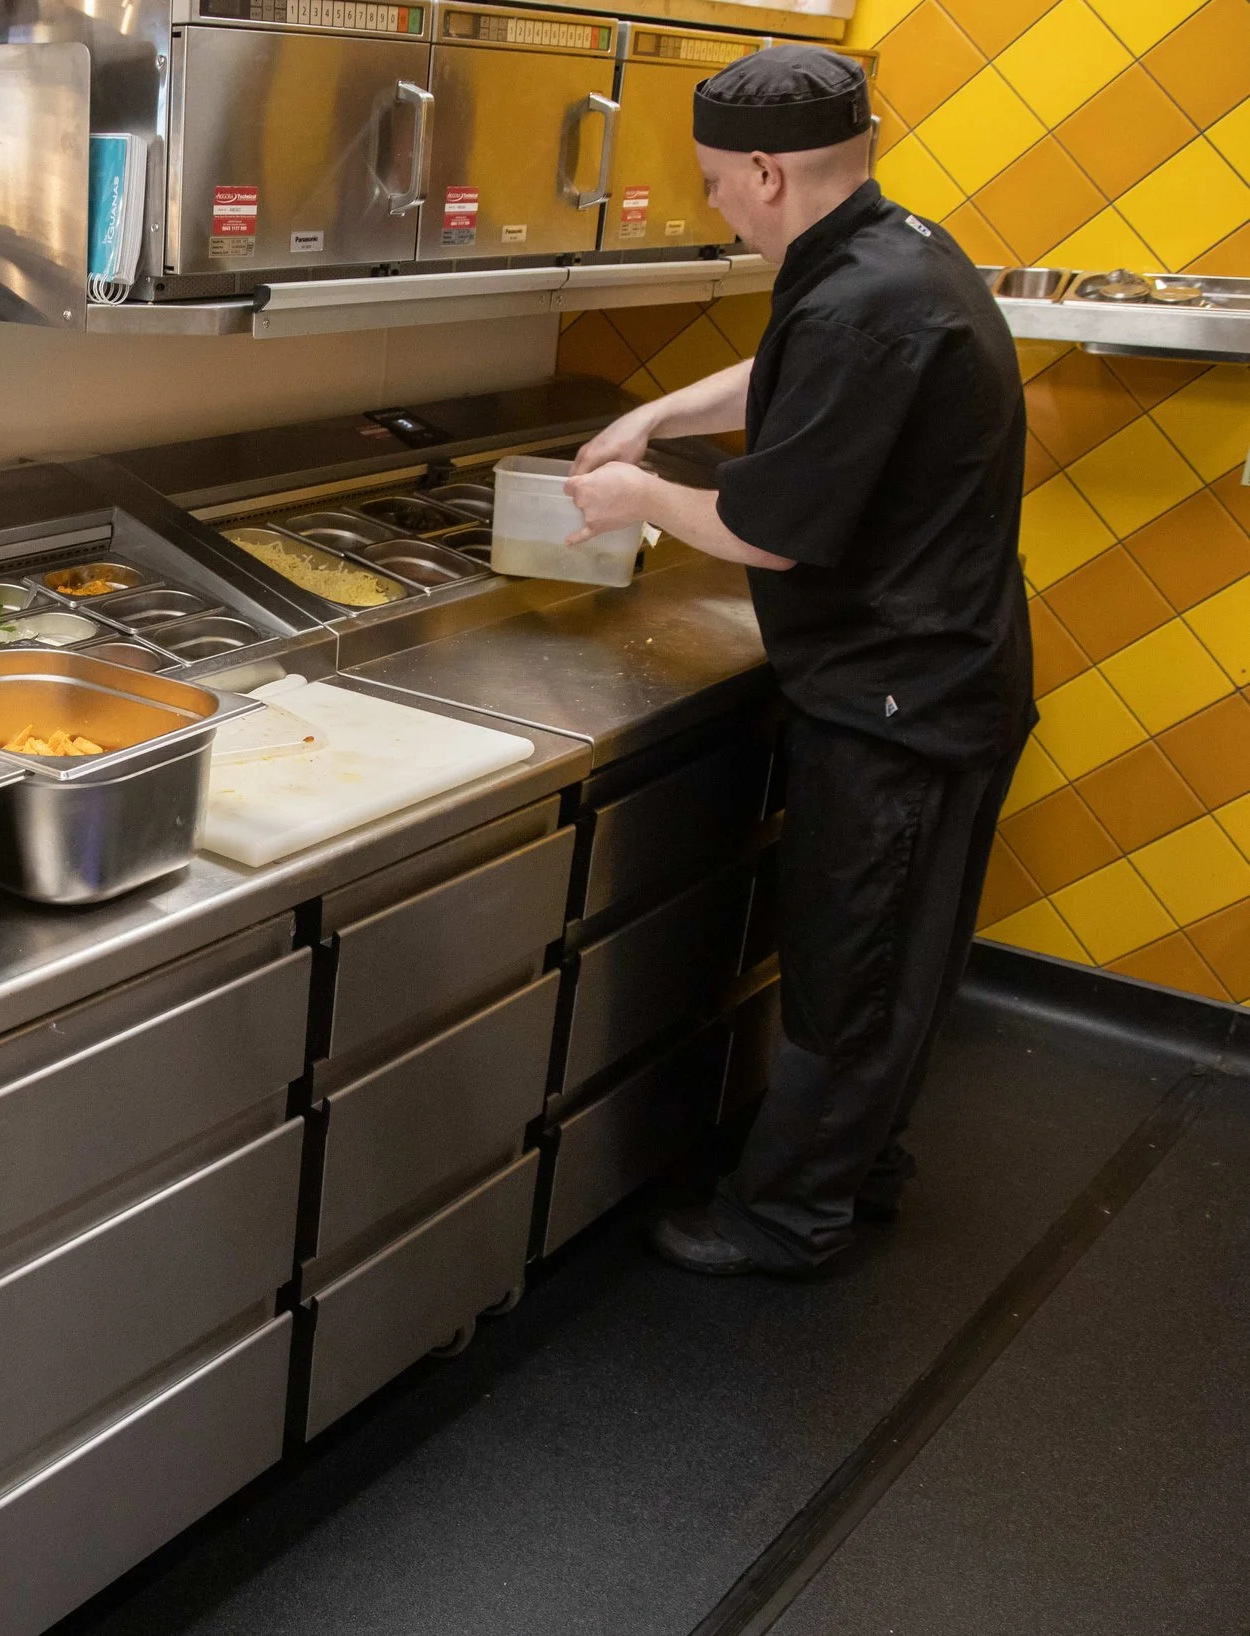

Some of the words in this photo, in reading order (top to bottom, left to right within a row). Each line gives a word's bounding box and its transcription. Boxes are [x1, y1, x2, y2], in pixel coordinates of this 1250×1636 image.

[291, 5, 294, 15] 1
[302, 6, 307, 16] 2
[314, 8, 318, 17] 3
[325, 9, 329, 17] 4
[336, 10, 341, 19] 5
[347, 10, 352, 20] 6
[358, 11, 363, 20] 7
[369, 13, 374, 22] 8
[380, 13, 385, 23] 9
[391, 14, 395, 23] 0
[107, 176, 119, 244] IGUANAS
